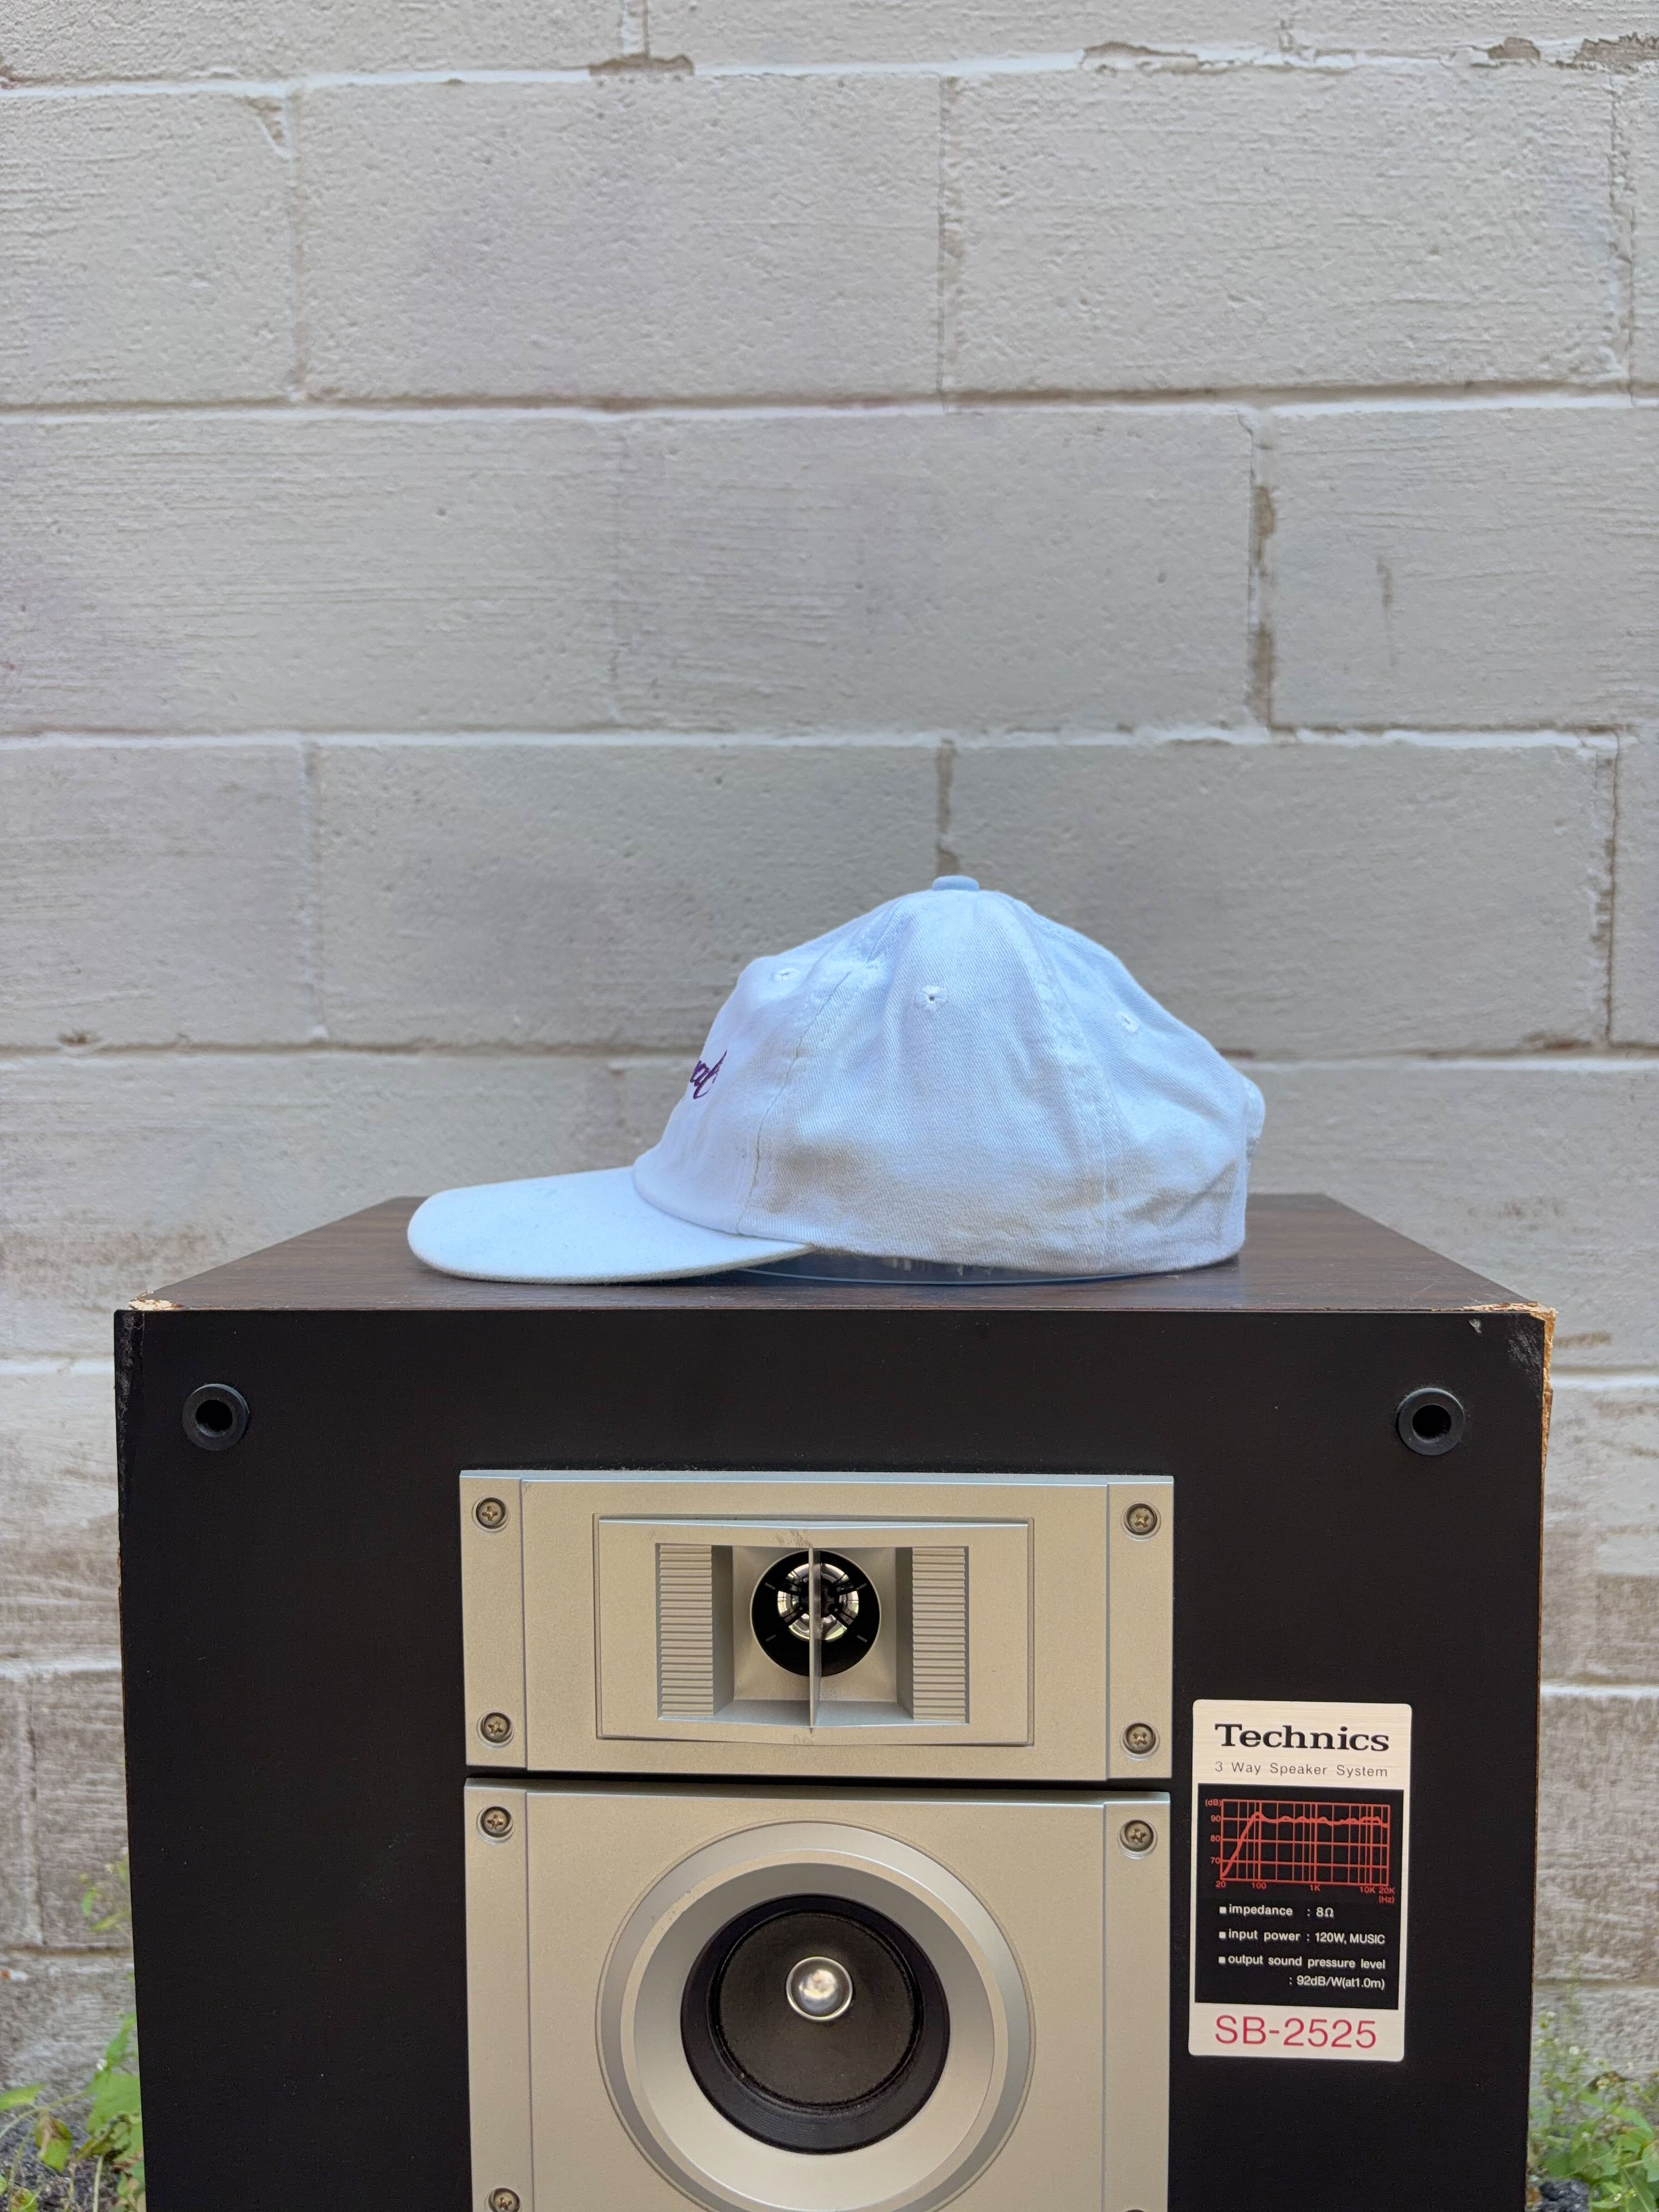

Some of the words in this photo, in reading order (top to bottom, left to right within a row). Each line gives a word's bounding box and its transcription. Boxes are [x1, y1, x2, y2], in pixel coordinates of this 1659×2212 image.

[1215, 1723, 1389, 1752] Technics
[1215, 1761, 1223, 1772] 3
[1232, 1762, 1261, 1775] Way
[1269, 1762, 1328, 1777] Speaker
[1336, 1765, 1388, 1778] System
[1205, 1798, 1222, 1807] (dB)
[1360, 1886, 1375, 1894] 10K
[1378, 1895, 1395, 1905] (Hz)
[1229, 1904, 1293, 1917] impedance
[1316, 1907, 1334, 1918] 8Ω
[1228, 1928, 1258, 1942] input
[1263, 1932, 1300, 1942] power
[1350, 1934, 1385, 1944] MUSIC
[1228, 1954, 1263, 1965] output
[1268, 1956, 1302, 1966] sound
[1307, 1959, 1356, 1968] pressure
[1361, 1959, 1386, 1970] level
[1215, 2015, 1376, 2049] SB-2525
